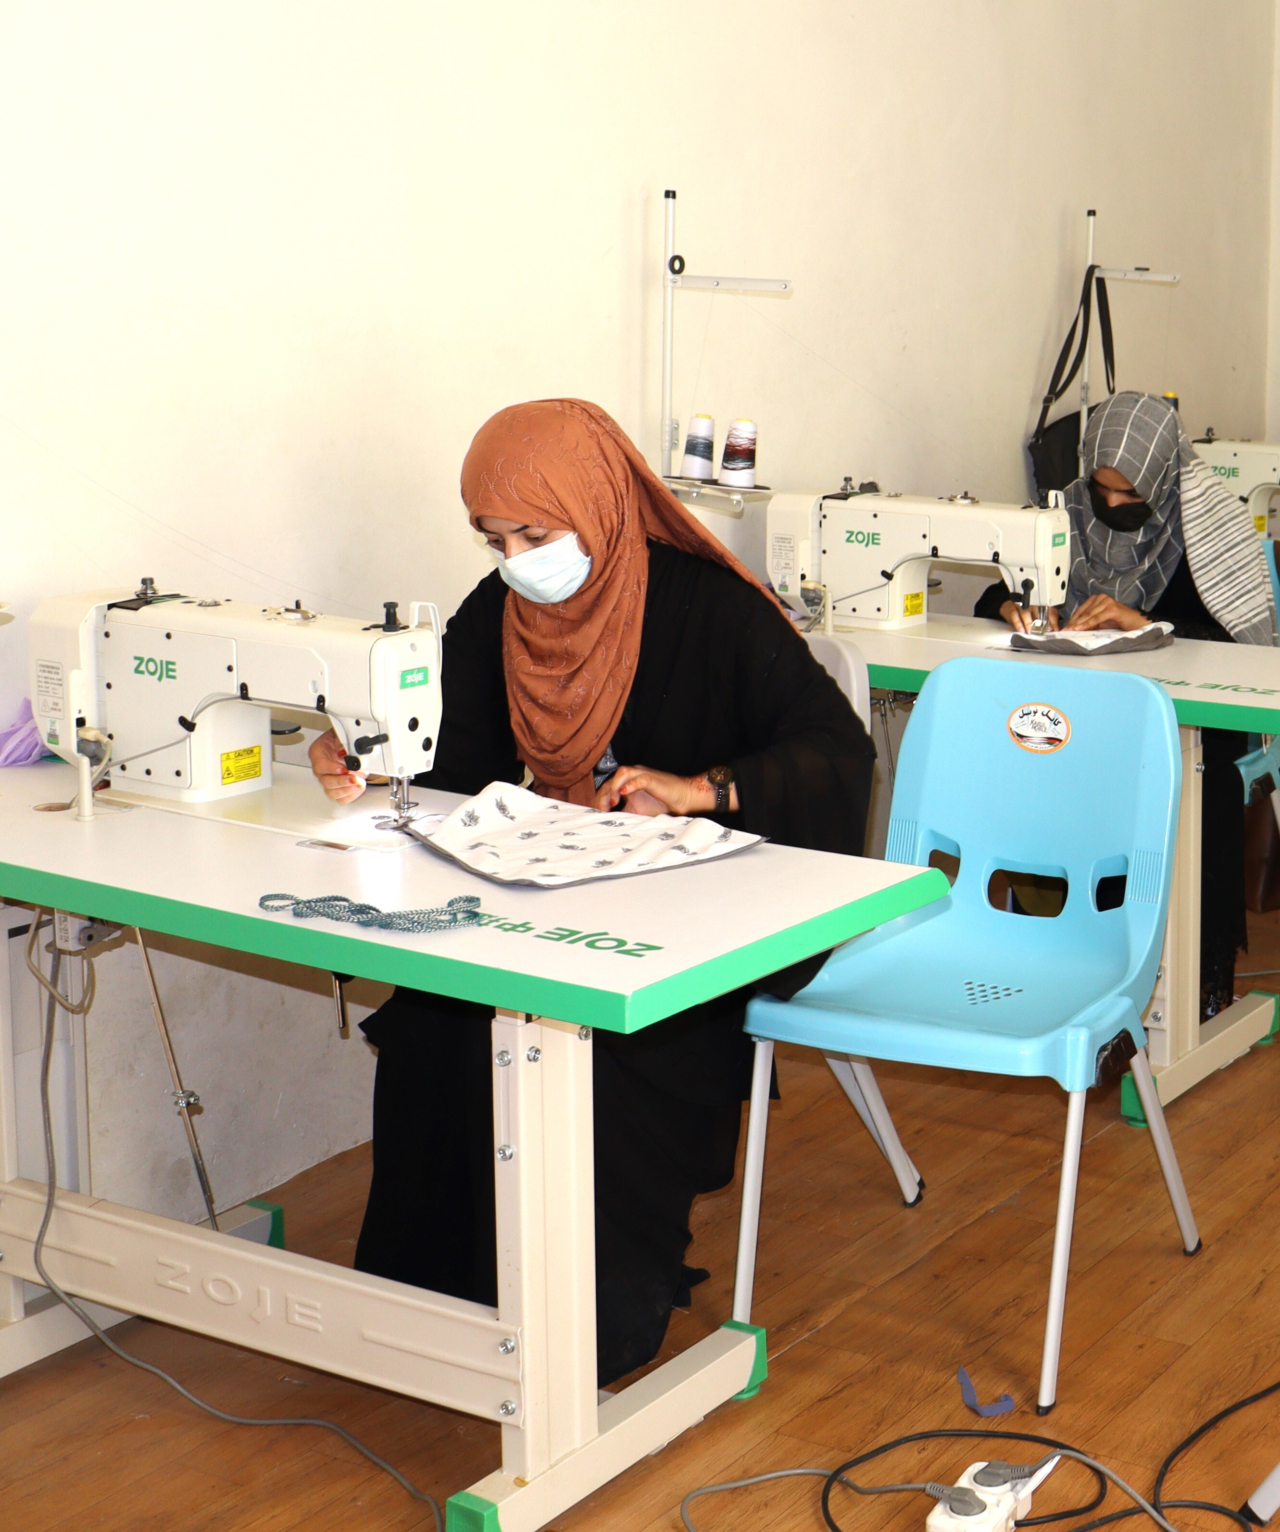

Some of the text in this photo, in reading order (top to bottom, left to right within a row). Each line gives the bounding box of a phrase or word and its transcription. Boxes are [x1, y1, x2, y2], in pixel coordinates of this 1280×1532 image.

[845, 530, 881, 548] ZOJE
[133, 656, 177, 683] ZOJE
[533, 926, 665, 958] ZOJE
[154, 1256, 324, 1333] ZOJE
